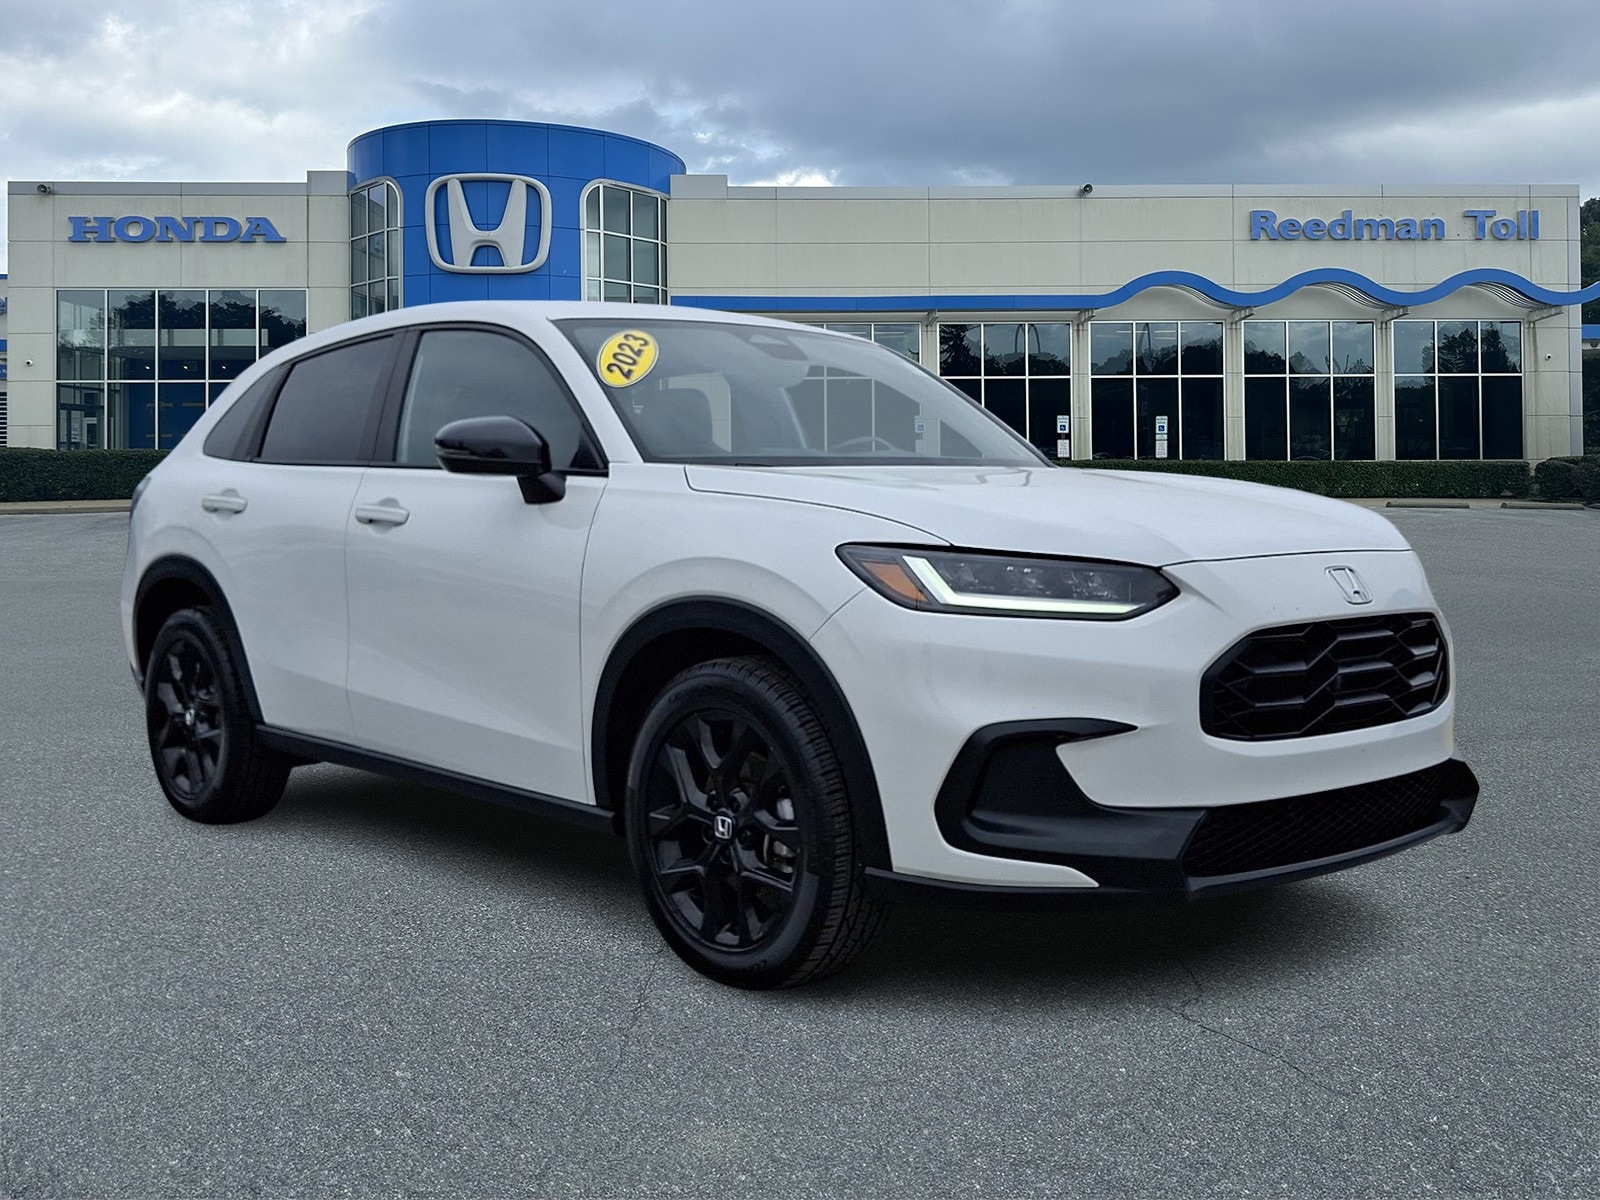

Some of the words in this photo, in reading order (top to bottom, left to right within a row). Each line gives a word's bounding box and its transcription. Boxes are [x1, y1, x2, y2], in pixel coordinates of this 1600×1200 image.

[67, 215, 287, 243] HONDA
[1250, 209, 1446, 241] Reedman
[1463, 209, 1540, 241] Toll
[606, 333, 649, 380] 2023
